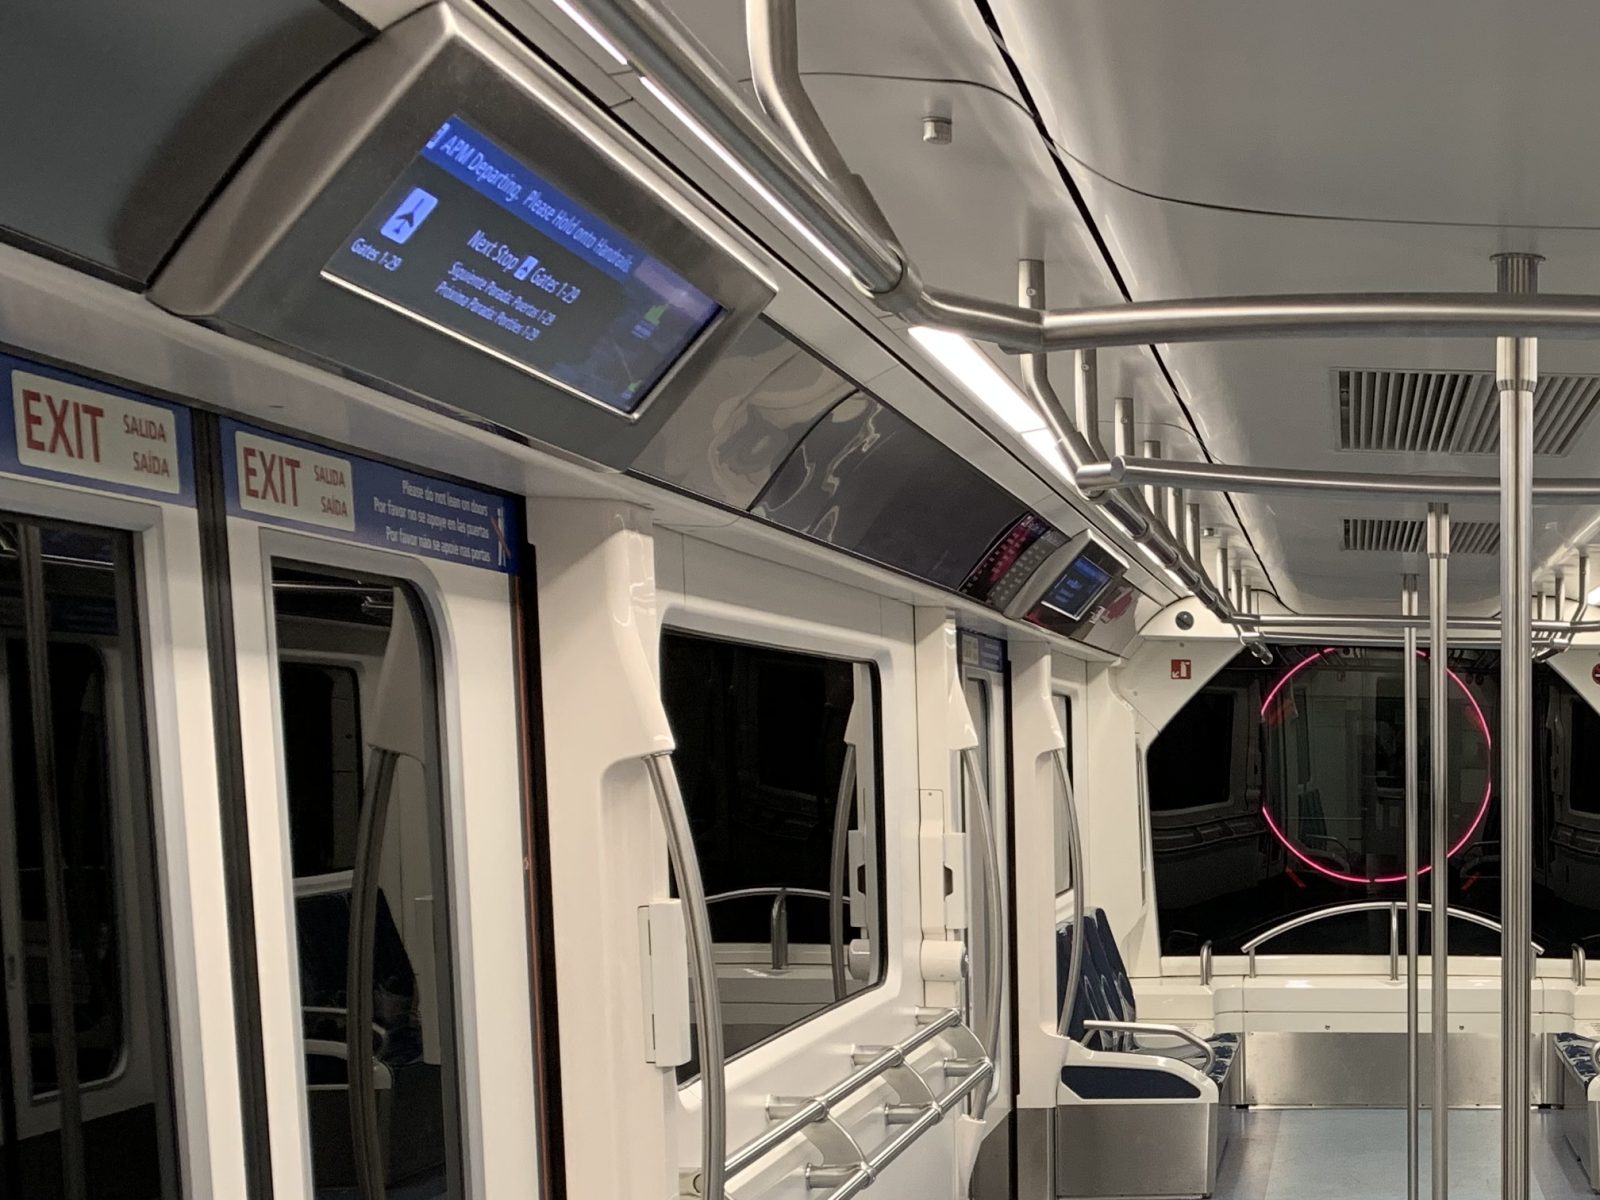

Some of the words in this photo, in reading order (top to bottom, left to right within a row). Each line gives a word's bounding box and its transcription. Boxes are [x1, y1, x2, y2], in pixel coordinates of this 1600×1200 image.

[440, 135, 475, 165] APM
[467, 152, 523, 203] Departing.
[523, 189, 556, 221] Please
[551, 209, 577, 236] Hold
[573, 220, 597, 249] onto
[351, 238, 381, 263] Gates
[377, 252, 403, 272] 1-29
[467, 229, 499, 259] Next
[492, 245, 520, 273] Stop
[530, 267, 560, 295] Gates
[555, 283, 582, 304] 1-29
[22, 388, 104, 463] EXIT
[123, 413, 166, 443] SALIDA
[133, 450, 170, 478] SAÍDA
[242, 446, 301, 507] EXIT
[313, 464, 345, 489] SALIDA
[320, 495, 348, 518] SAÍDA
[373, 496, 387, 514] Por
[387, 499, 407, 519] favor
[407, 508, 417, 521] no
[426, 512, 447, 531] apoye
[447, 518, 457, 531] en
[457, 518, 466, 533] las
[466, 522, 490, 540] puertas
[402, 479, 424, 499] Please
[424, 486, 434, 502] do
[435, 491, 446, 505] not
[447, 491, 461, 508] lean
[461, 499, 470, 511] on
[470, 500, 488, 517] doors
[386, 525, 398, 542] Por
[399, 527, 418, 547] favor
[418, 533, 432, 550] não
[441, 539, 459, 556] apoie
[459, 545, 471, 558] nas
[471, 547, 491, 563] portas
